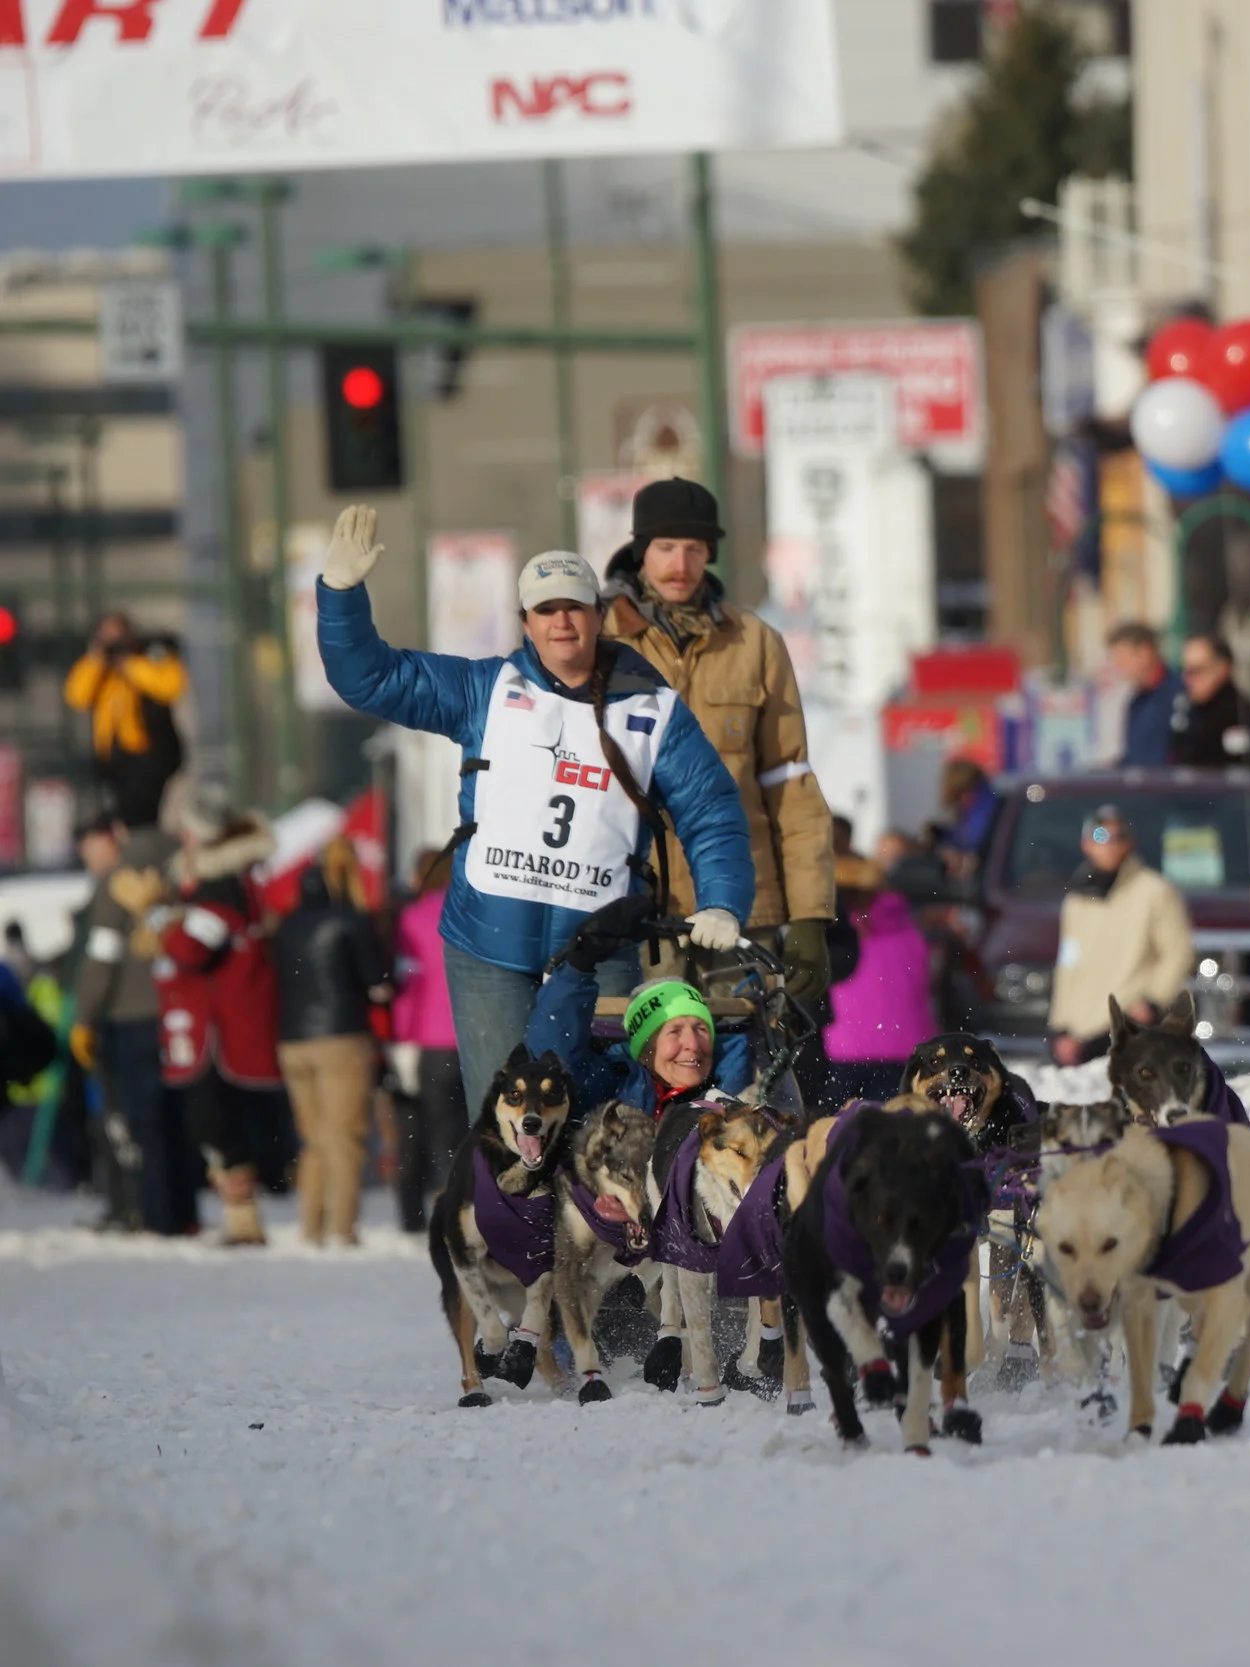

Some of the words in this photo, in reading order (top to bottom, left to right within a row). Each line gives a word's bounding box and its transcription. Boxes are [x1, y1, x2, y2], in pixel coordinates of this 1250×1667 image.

[490, 71, 630, 119] NAC
[555, 760, 614, 792] GCI
[542, 794, 576, 849] 3
[484, 846, 581, 880] IDITAROD
[585, 863, 613, 888] '16
[492, 870, 599, 898] www.iditarod.com
